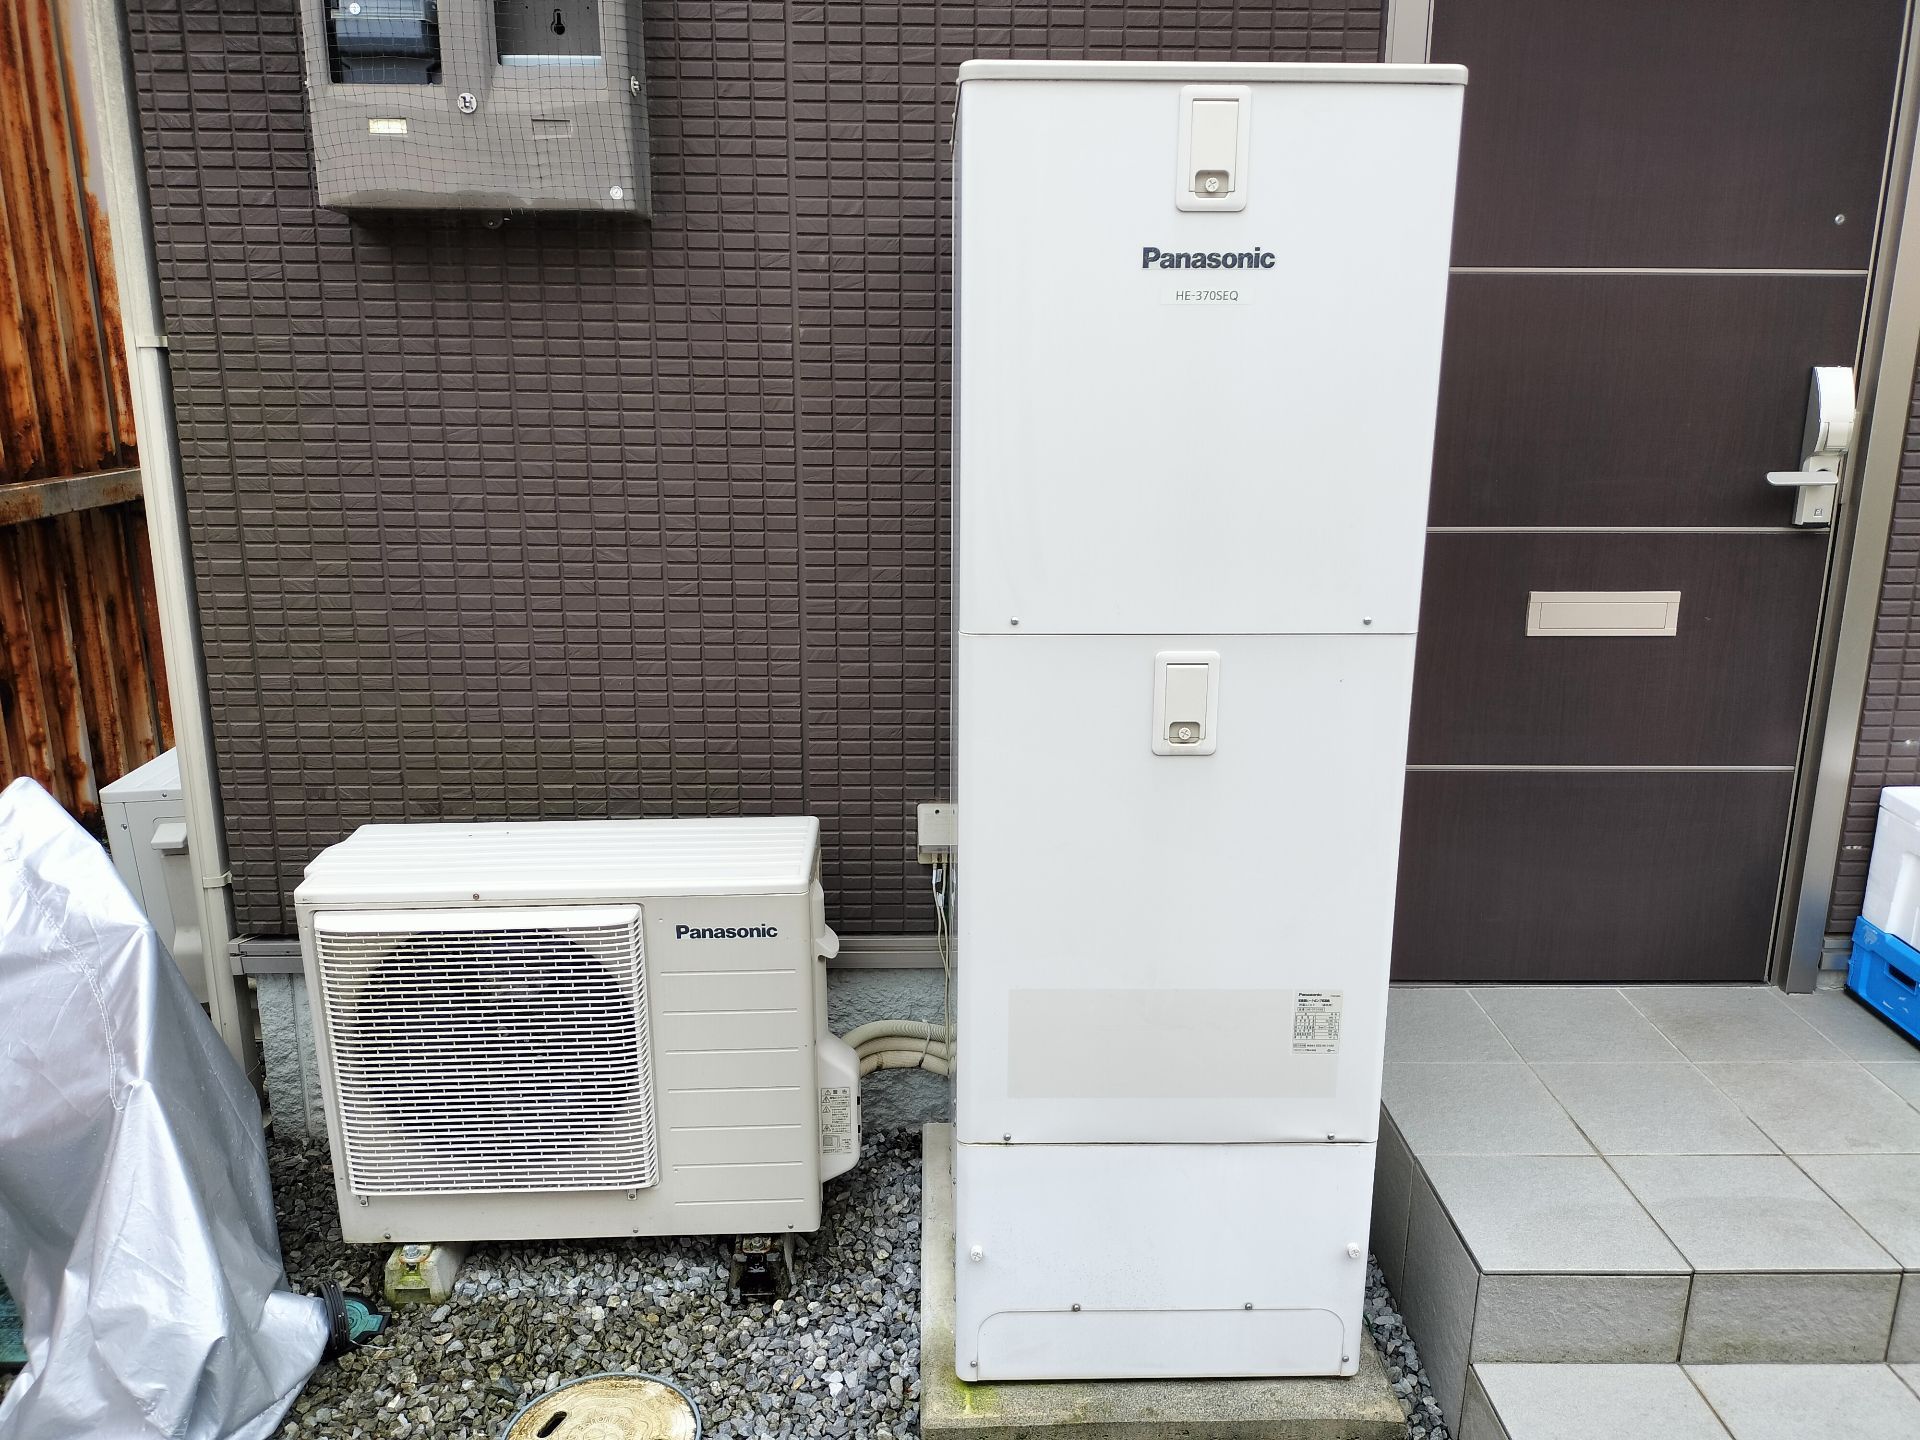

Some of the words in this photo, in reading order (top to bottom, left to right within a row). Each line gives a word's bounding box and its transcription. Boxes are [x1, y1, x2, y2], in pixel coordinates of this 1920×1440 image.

[1142, 246, 1276, 269] Panasonic
[1175, 290, 1239, 302] HE-370SEQ
[675, 923, 778, 940] Panasonic
